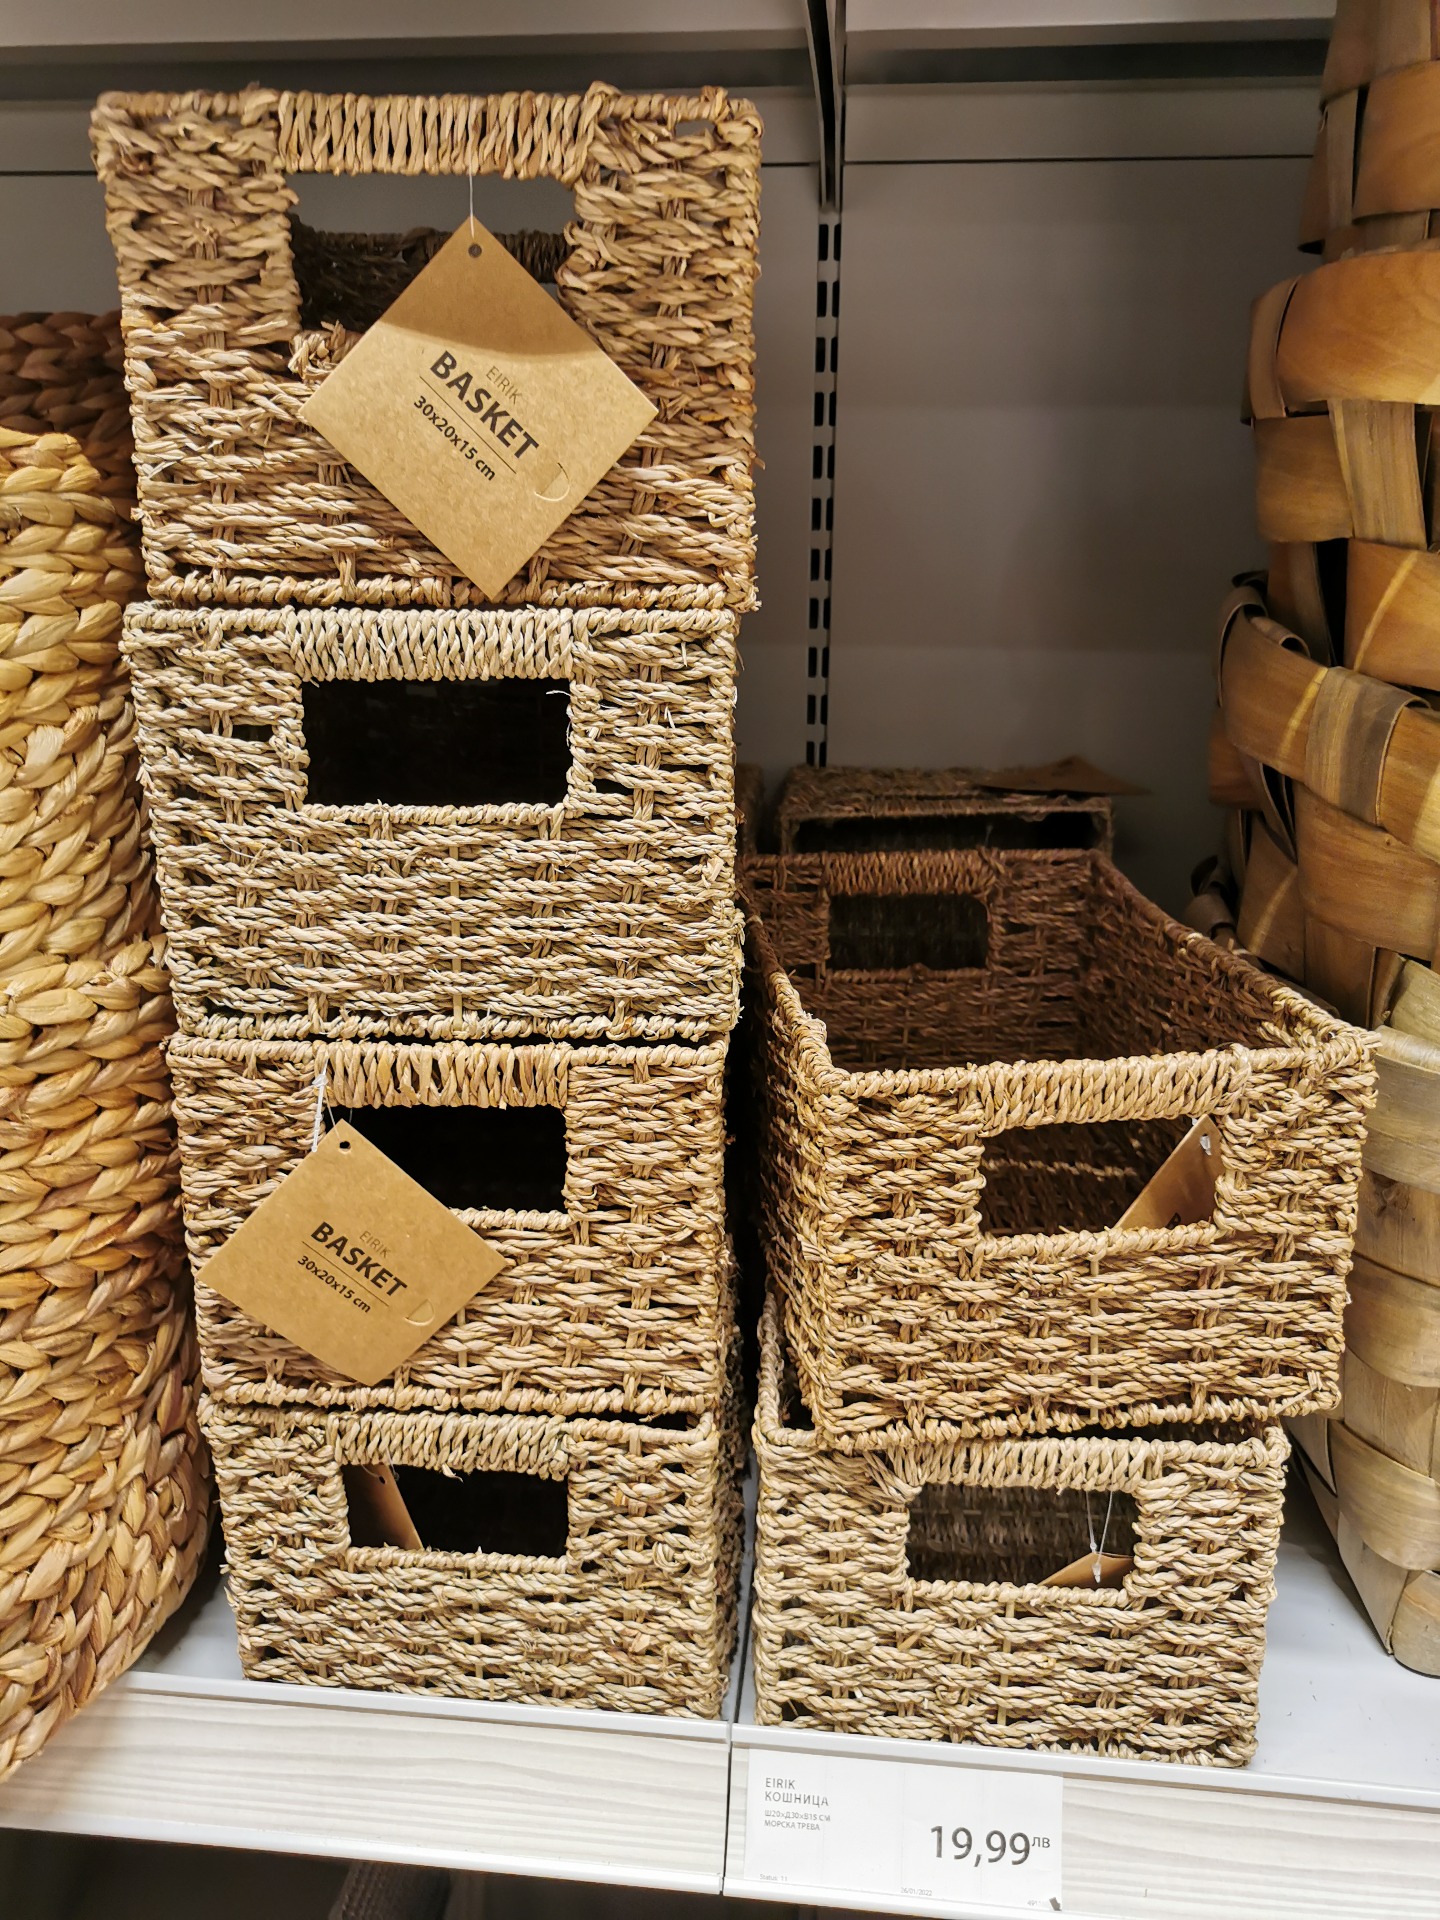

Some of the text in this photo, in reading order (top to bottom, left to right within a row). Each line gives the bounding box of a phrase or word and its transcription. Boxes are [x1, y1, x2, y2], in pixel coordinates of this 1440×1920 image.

[430, 350, 540, 459] BASKET
[486, 365, 522, 405] EIRIK
[413, 395, 496, 481] 30x20x15 cm
[310, 1221, 408, 1296] BASKET
[359, 1230, 391, 1259] EIRIK
[297, 1255, 371, 1313] 30x20x15 cm
[764, 1791, 829, 1808] КОШНИЦА
[765, 1777, 796, 1790] EIRIK
[764, 1819, 820, 1831] МОРСКА ТРЕВА
[931, 1825, 1031, 1867] 19,99
